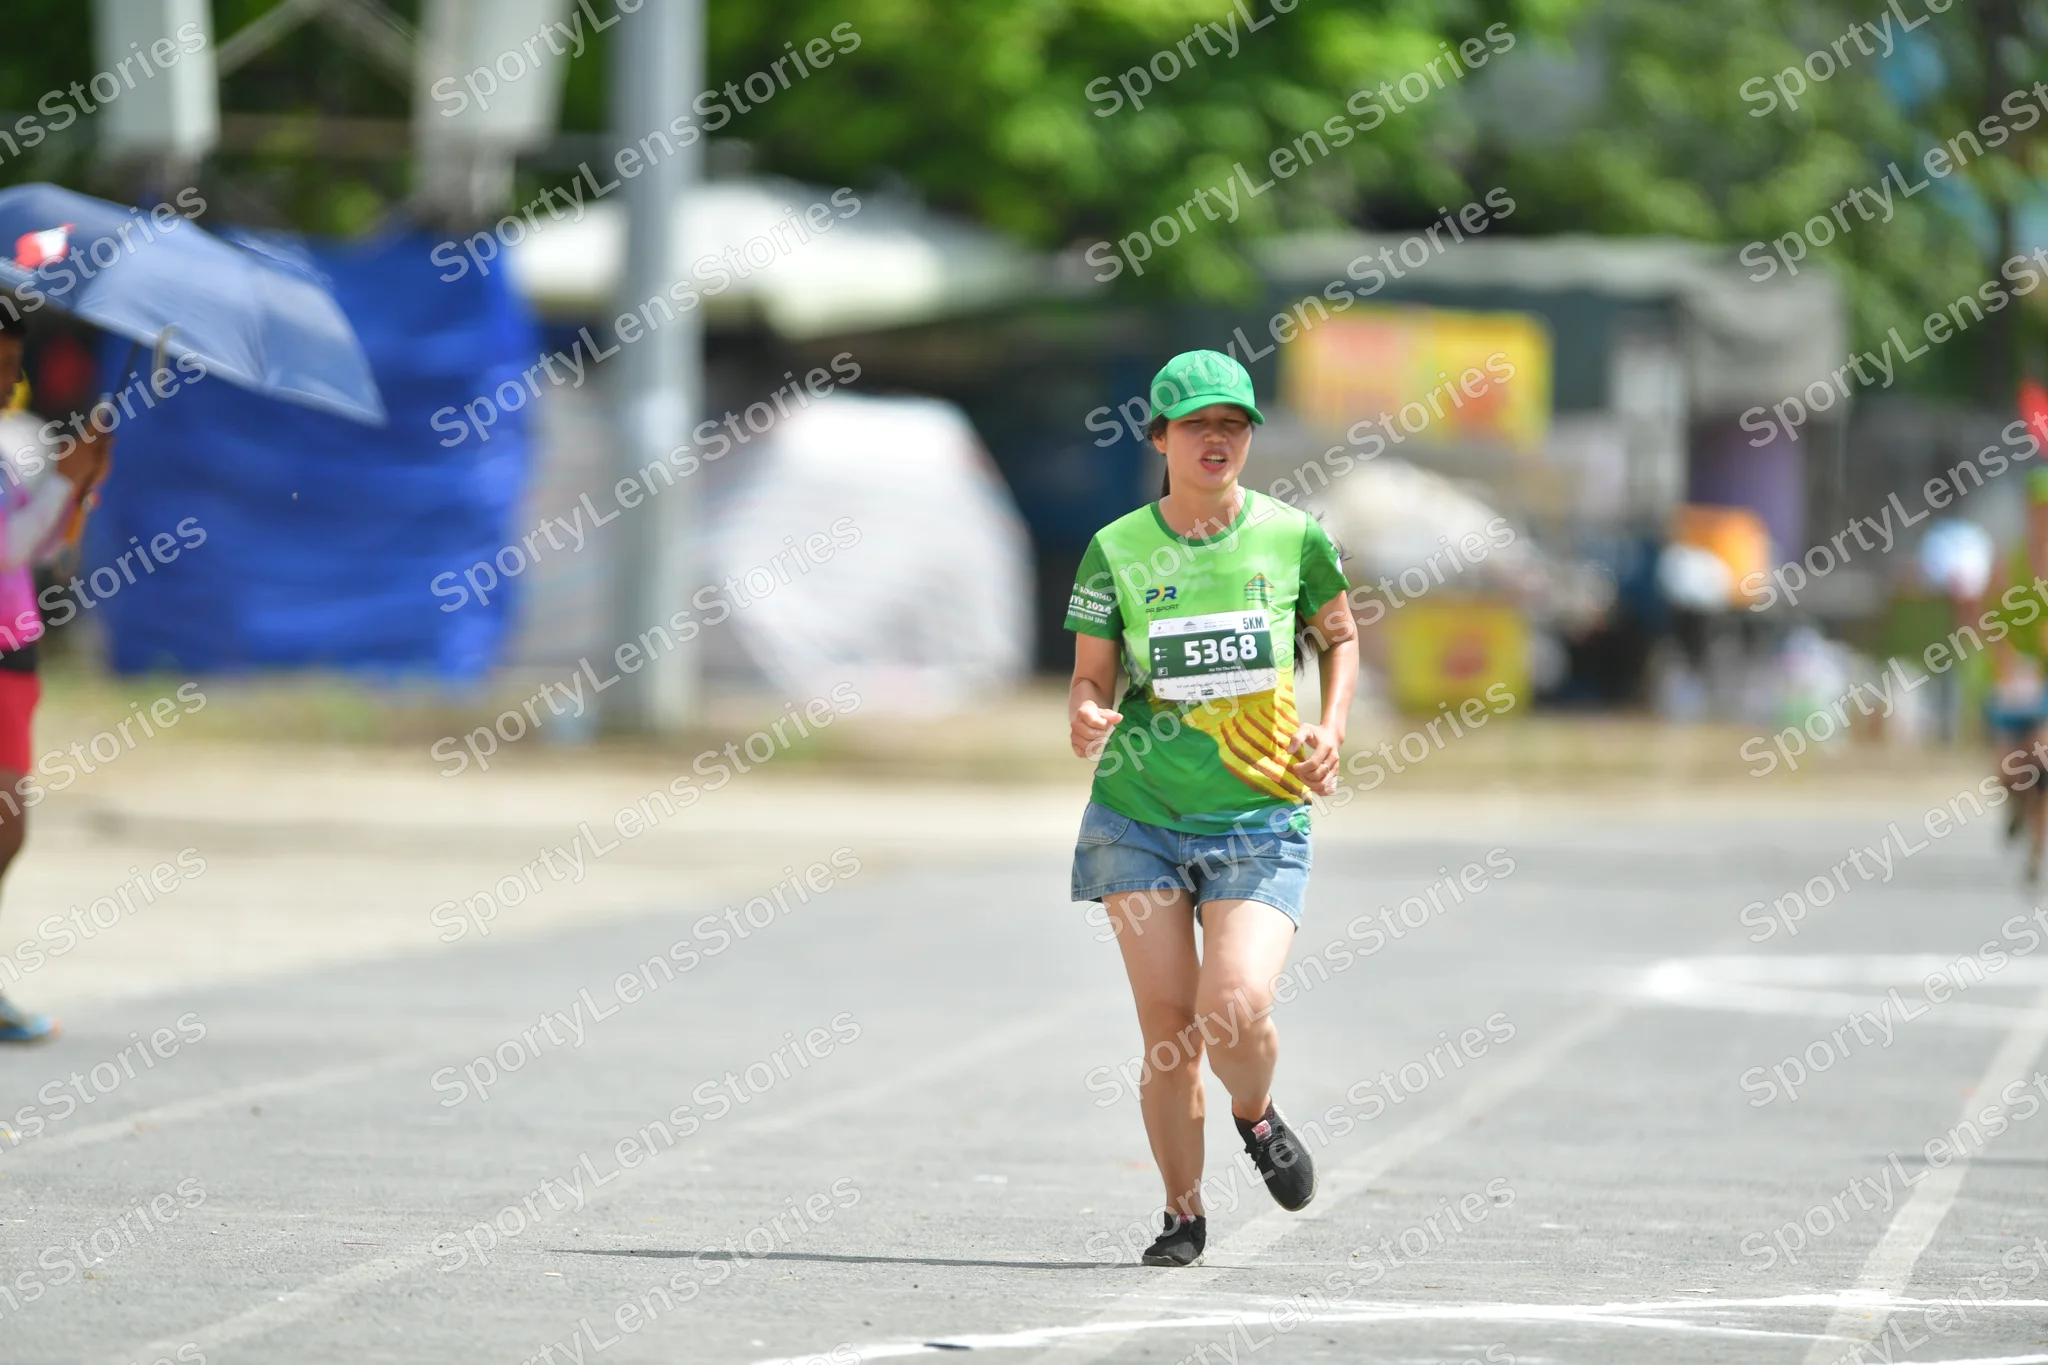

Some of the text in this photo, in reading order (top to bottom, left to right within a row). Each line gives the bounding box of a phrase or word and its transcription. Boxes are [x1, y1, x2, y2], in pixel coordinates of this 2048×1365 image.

[1156, 604, 1179, 613] SPORT
[1243, 616, 1265, 630] 5KM
[1184, 634, 1258, 666] 5368
